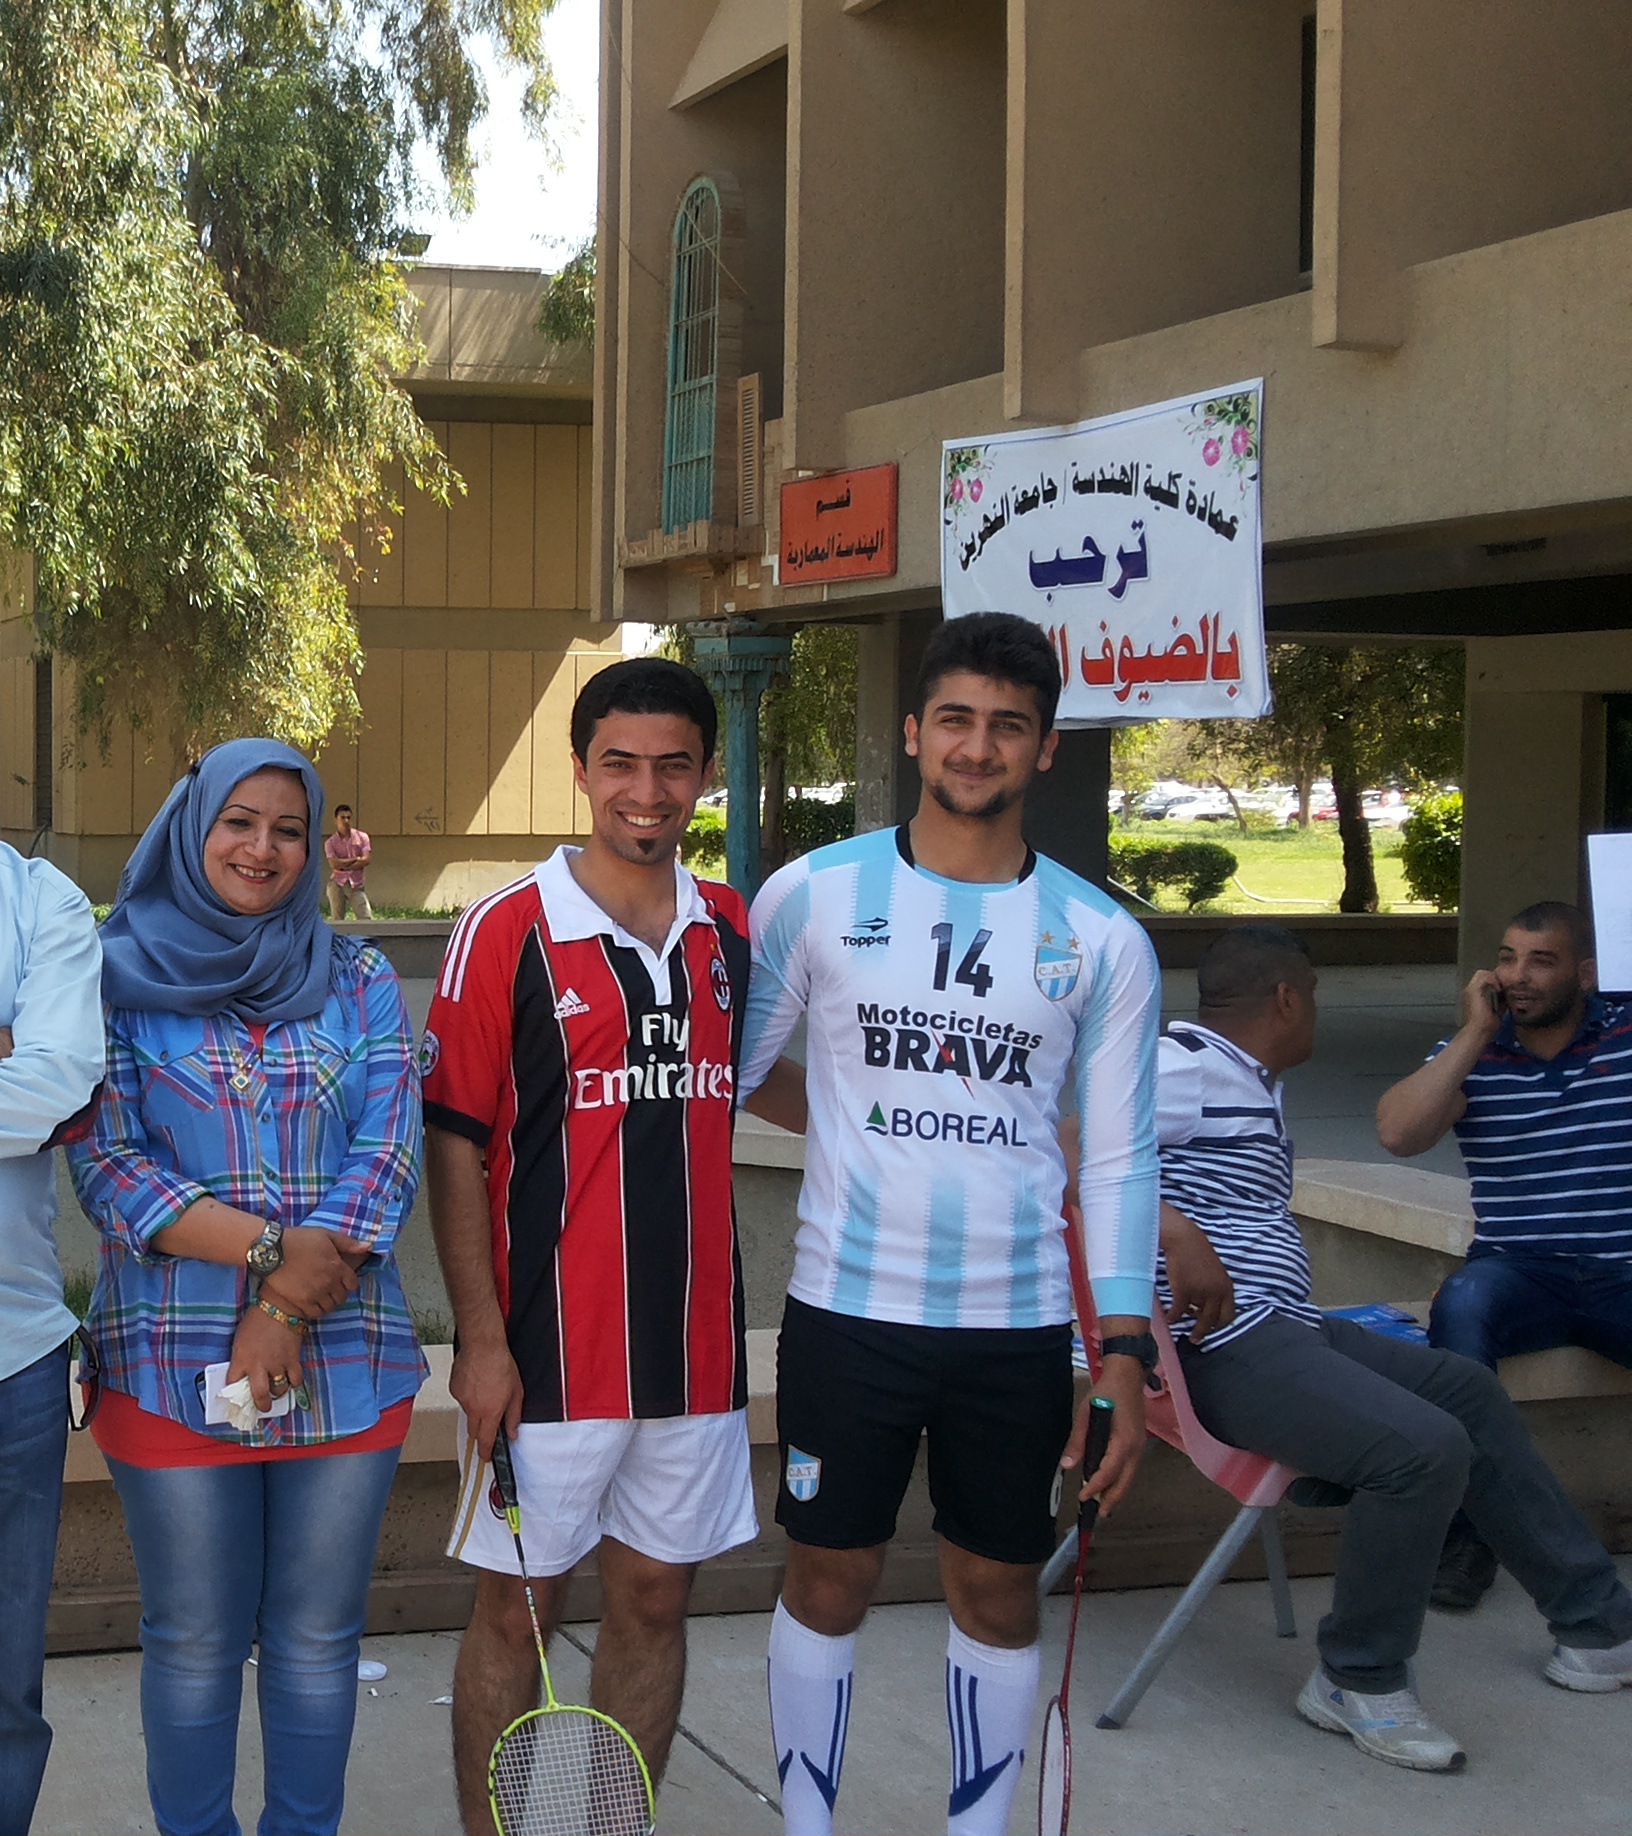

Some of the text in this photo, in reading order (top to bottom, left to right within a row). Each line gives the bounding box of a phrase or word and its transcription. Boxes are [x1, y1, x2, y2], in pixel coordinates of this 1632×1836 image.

[815, 479, 851, 521] قسم
[1011, 471, 1058, 516] جامعة
[1071, 461, 1140, 497] الهندسة
[1143, 463, 1183, 511] كلية
[959, 491, 1010, 572] النهرين
[1185, 478, 1239, 542] عمادة
[786, 527, 885, 571] الهندسة المعمارية
[1028, 518, 1148, 602] ترحب
[1080, 611, 1241, 702] بالضيوف
[839, 933, 892, 949] Topper
[930, 922, 994, 998] 14
[553, 1002, 592, 1021] adidas
[640, 1012, 690, 1052] Fly
[856, 1002, 1044, 1050] Motocicletas
[860, 1025, 1034, 1089] BRAVA
[574, 1053, 733, 1110] Emirates
[891, 1107, 1029, 1147] BOREAL
